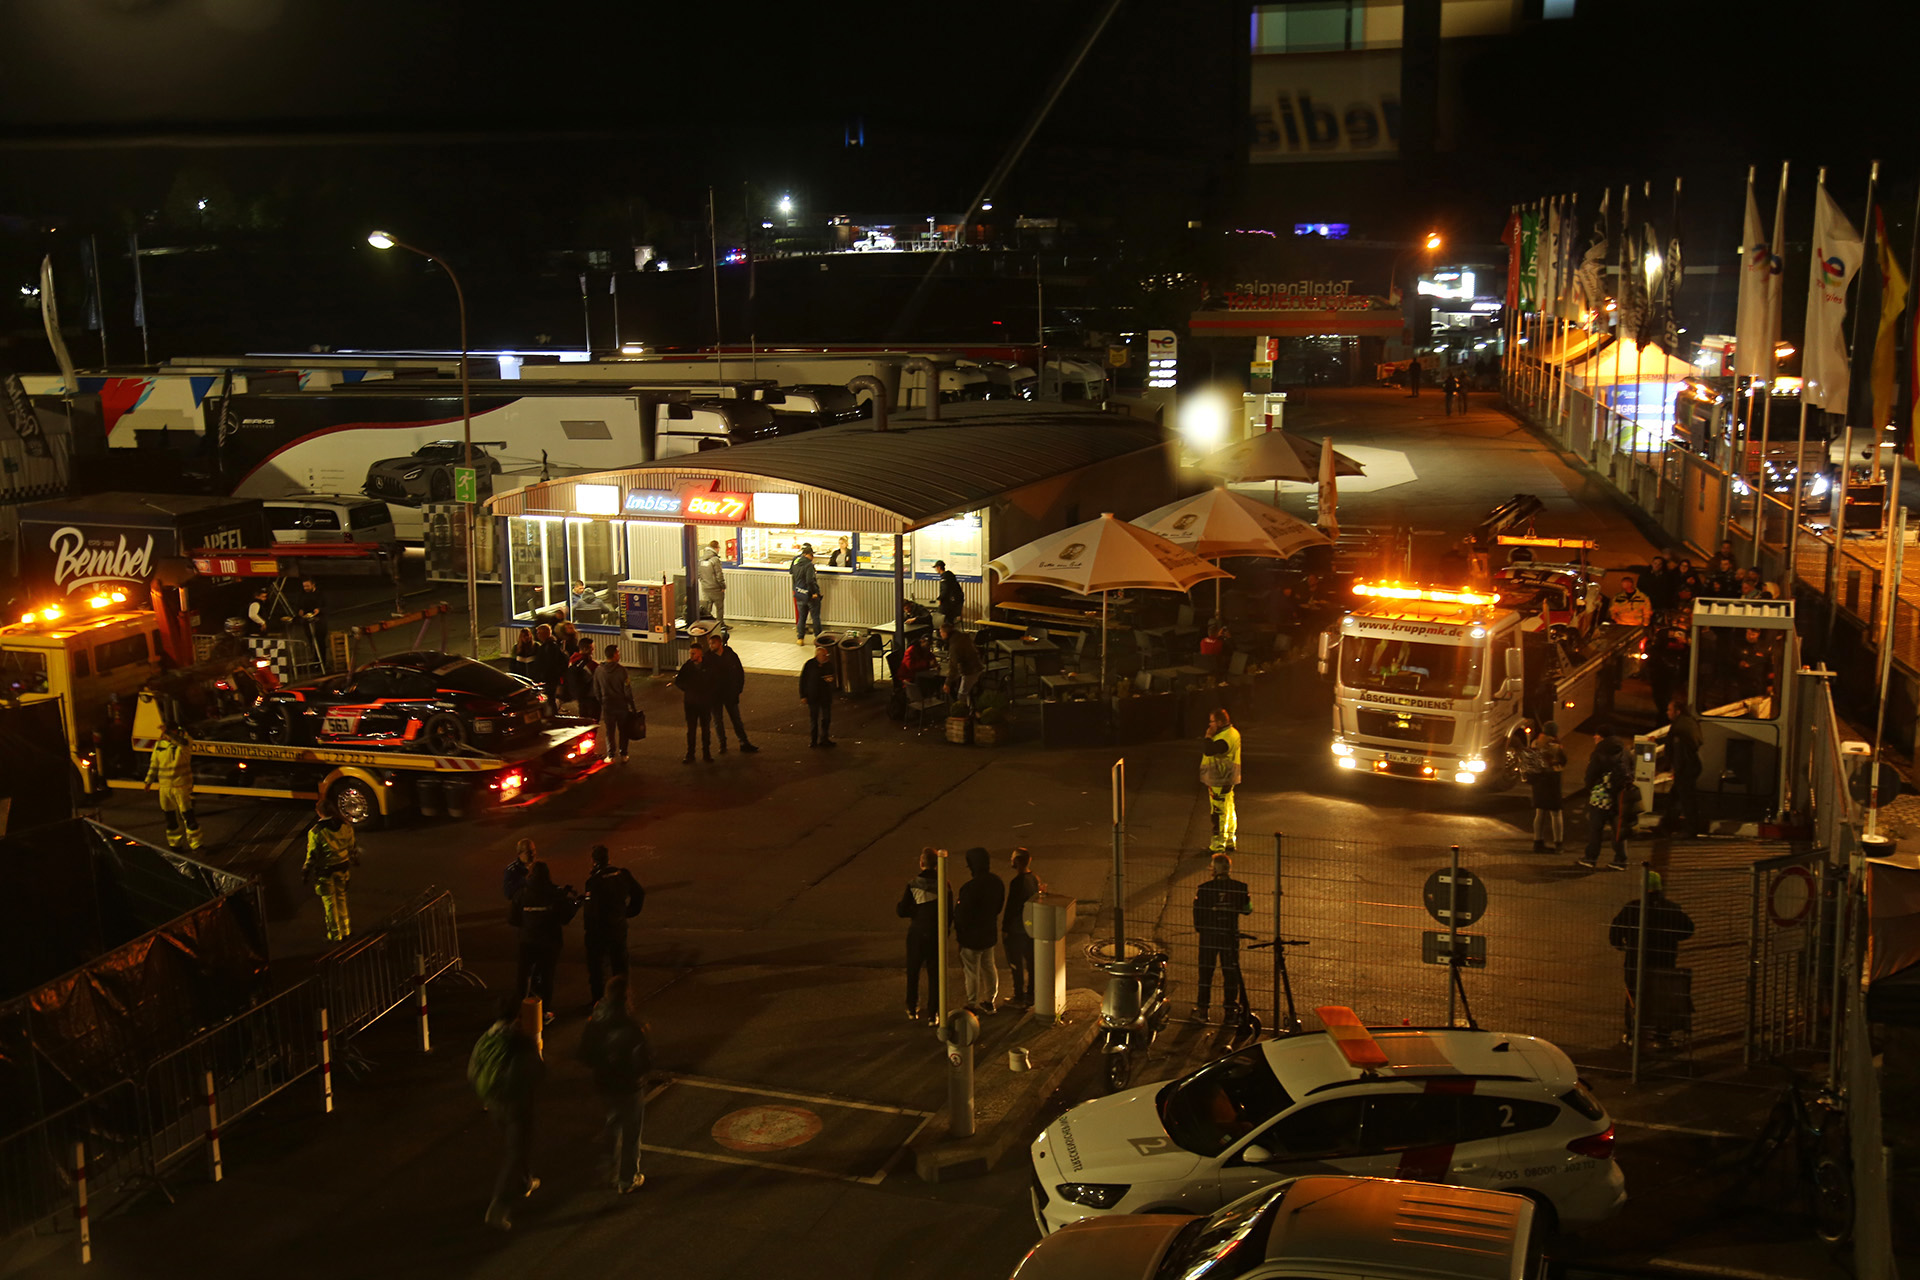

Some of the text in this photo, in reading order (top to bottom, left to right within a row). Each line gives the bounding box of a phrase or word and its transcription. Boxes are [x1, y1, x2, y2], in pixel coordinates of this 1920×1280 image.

[203, 528, 247, 549] APFEL
[50, 526, 154, 586] Bembel
[219, 559, 238, 574] 1110
[1358, 620, 1464, 638] www.kruppmk.de
[1359, 692, 1455, 711] ABSCHLEPPDIENST
[327, 718, 350, 733] 563
[1499, 1104, 1515, 1127] 2
[1138, 1137, 1168, 1155] 2
[1498, 1170, 1519, 1181] SOS
